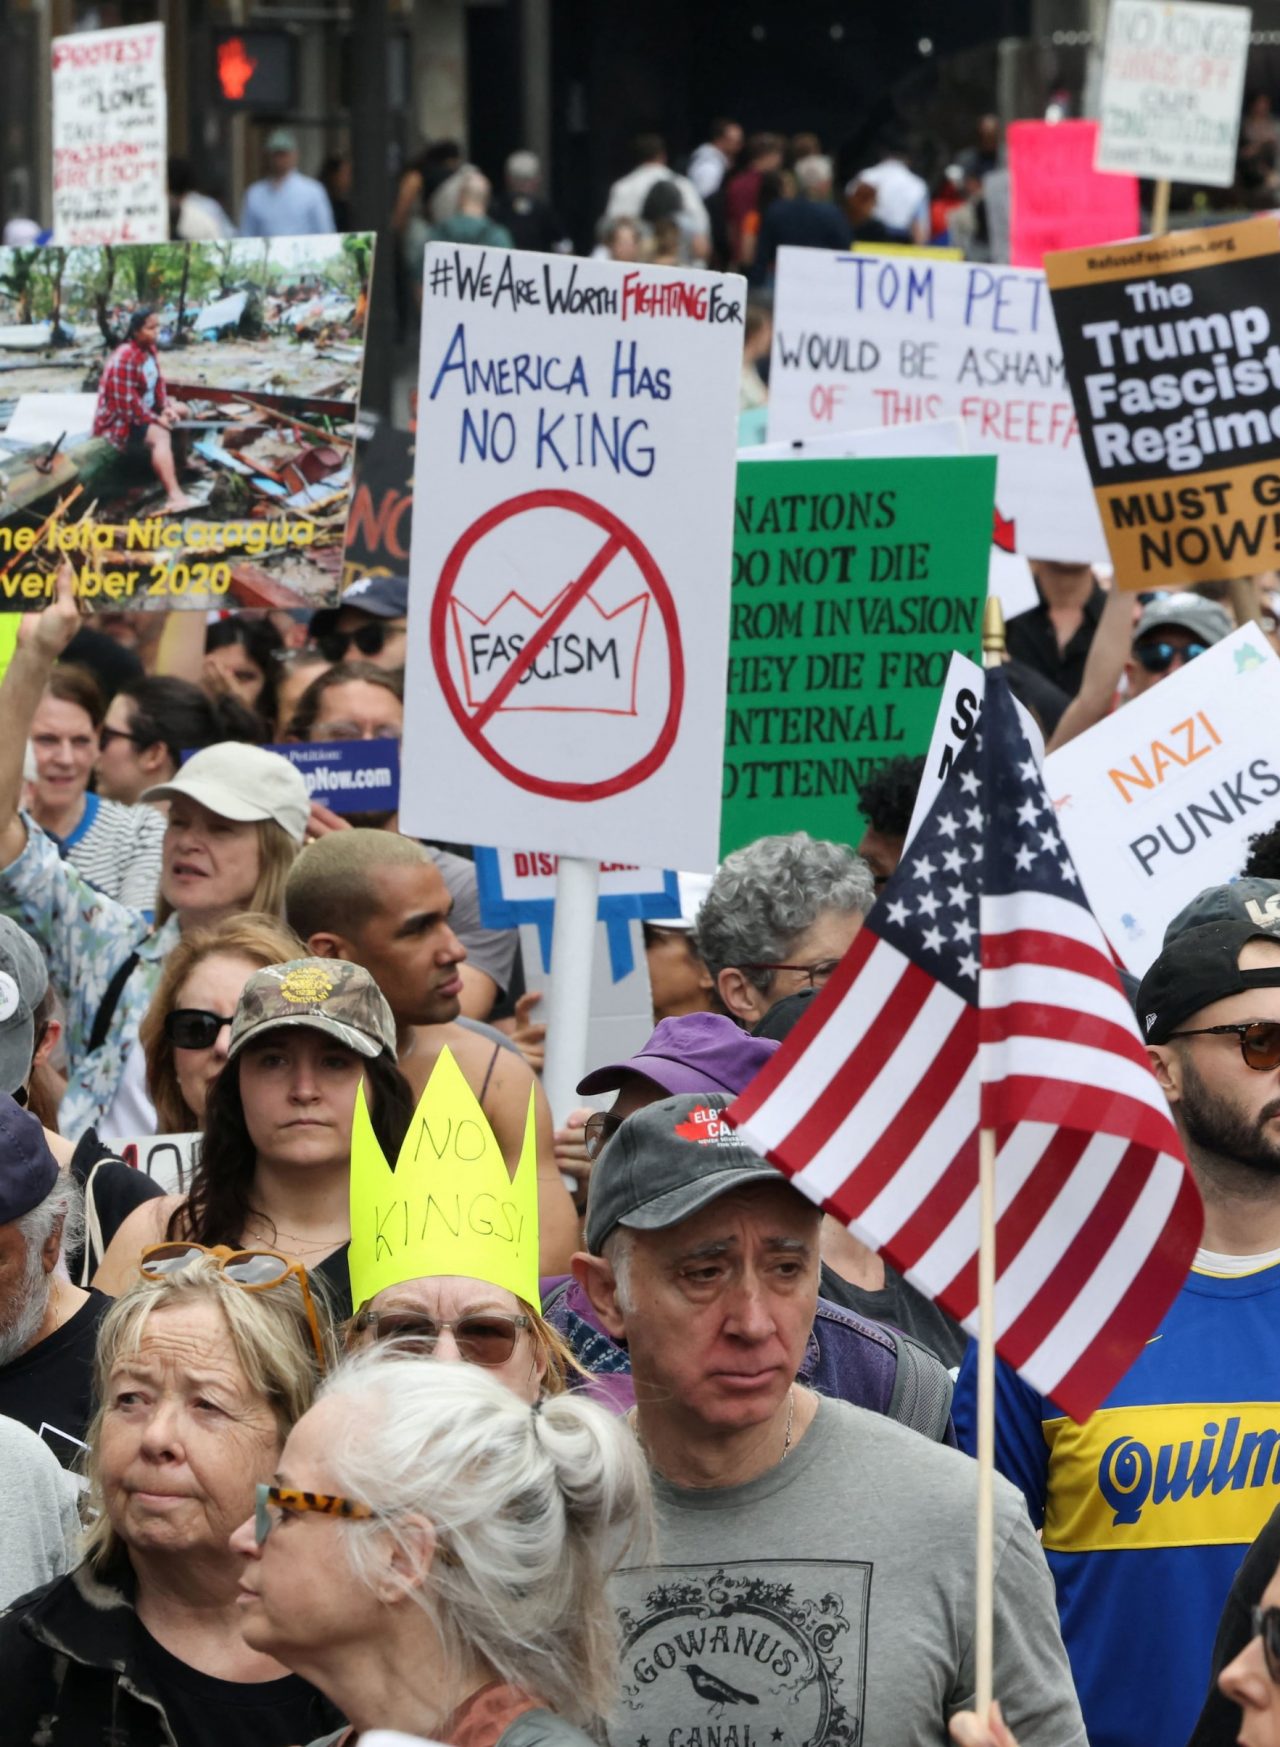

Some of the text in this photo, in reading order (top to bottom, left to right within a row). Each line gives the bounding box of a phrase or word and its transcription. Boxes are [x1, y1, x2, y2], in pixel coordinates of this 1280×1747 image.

[52, 34, 157, 72] PROTEST
[97, 83, 156, 114] LOVE
[1086, 236, 1236, 271] RefuseFascism.org
[835, 256, 935, 320] TOM
[1125, 280, 1193, 313] The
[776, 333, 880, 375] WOULD
[898, 340, 940, 380] BE
[1081, 305, 1271, 368] Trump
[429, 322, 672, 400] AMERICA HAS
[809, 383, 848, 422] OF
[872, 388, 943, 428] THIS
[459, 407, 656, 477] NO KING
[733, 491, 897, 534] NATIONS
[1108, 482, 1233, 529] MUST
[127, 519, 316, 557] Nicaragua
[147, 563, 232, 598] 2020
[778, 546, 857, 586] NOT
[869, 543, 931, 583] DIE
[813, 596, 979, 638] INVASION
[469, 631, 621, 685] FASCISM
[805, 651, 865, 691] DIE
[1106, 710, 1224, 805] NAZI
[414, 1117, 487, 1162] NO
[706, 1119, 735, 1138] CA
[375, 1193, 524, 1262] KINGS!
[632, 1624, 802, 1686] GOWANUS
[667, 1723, 758, 1747] CANAL
